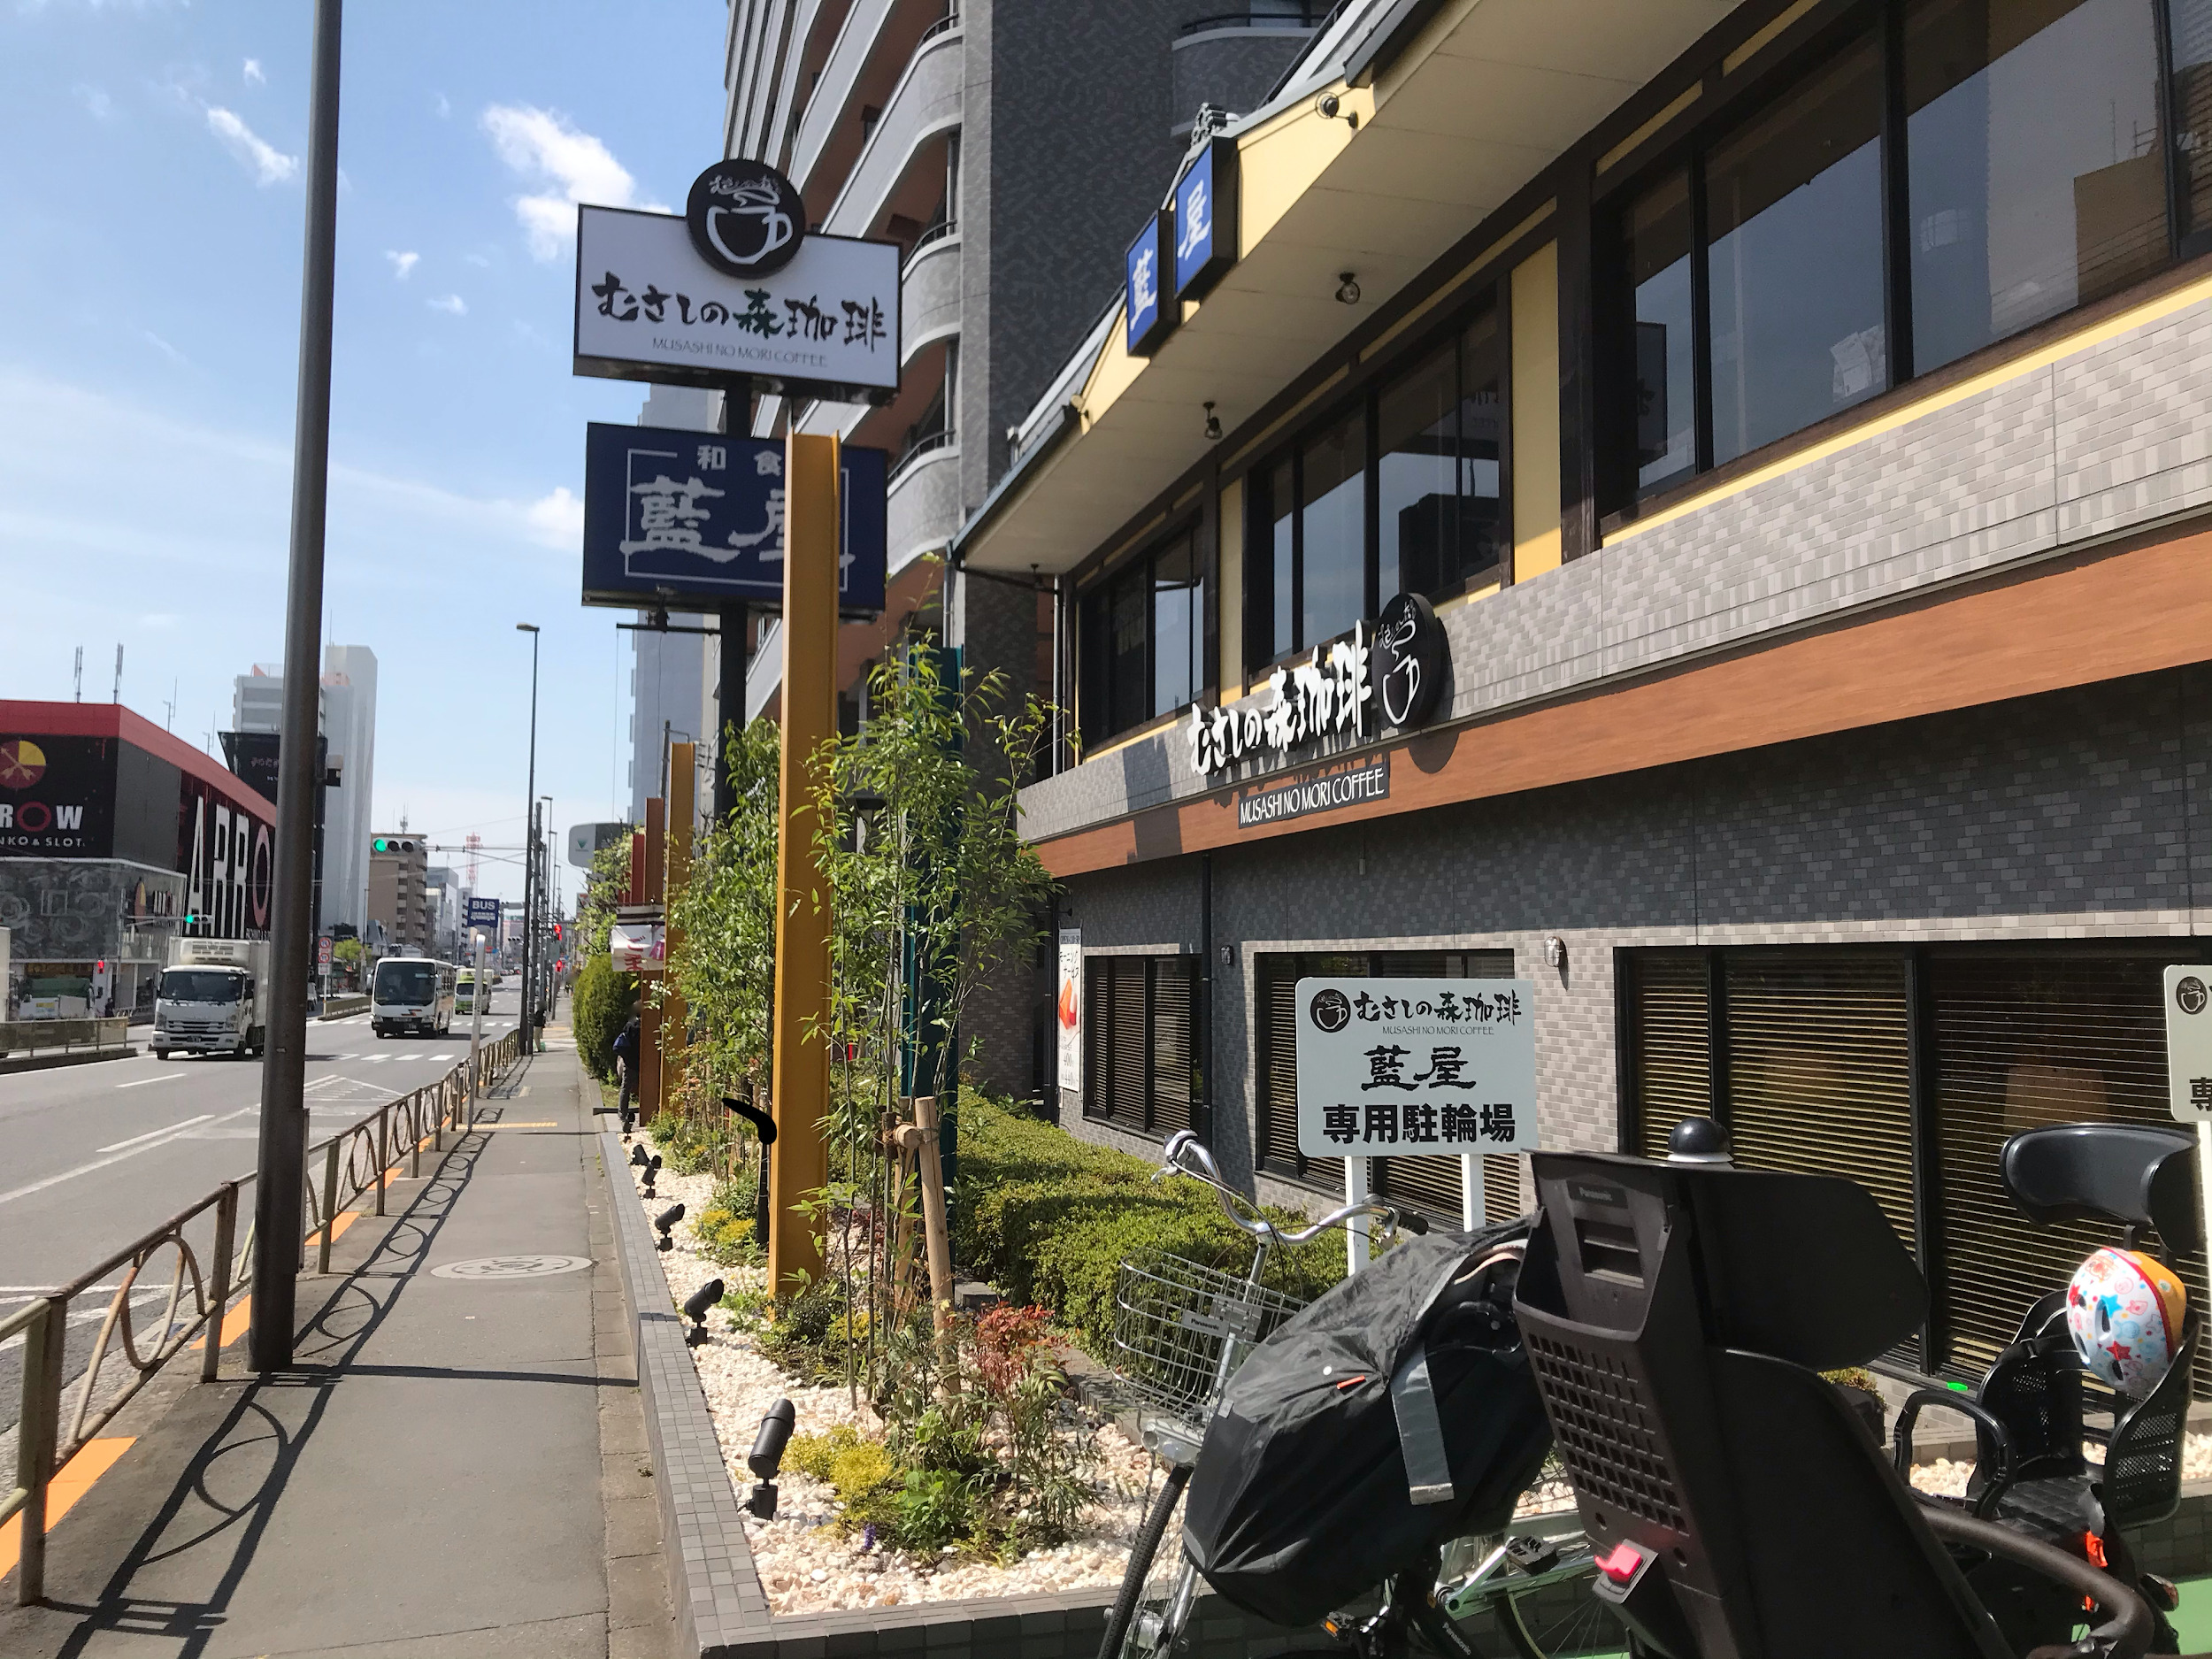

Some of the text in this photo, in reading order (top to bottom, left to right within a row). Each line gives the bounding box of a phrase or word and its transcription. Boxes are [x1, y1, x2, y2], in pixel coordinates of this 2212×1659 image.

[592, 271, 887, 352] むさしの森珈琲
[653, 337, 827, 367] MUSASHI NO MORI COFFEE
[1240, 768, 1385, 824] MUSASHI NO MORI COFFEE
[45, 837, 82, 847] SLOT
[472, 901, 495, 910] BUS
[1354, 989, 1522, 1025] むさしの森珈琲
[1361, 1044, 1476, 1091] 藍屋
[1323, 1103, 1515, 1143] 専用駐輪場
[1442, 1622, 1471, 1655] Panasonic
